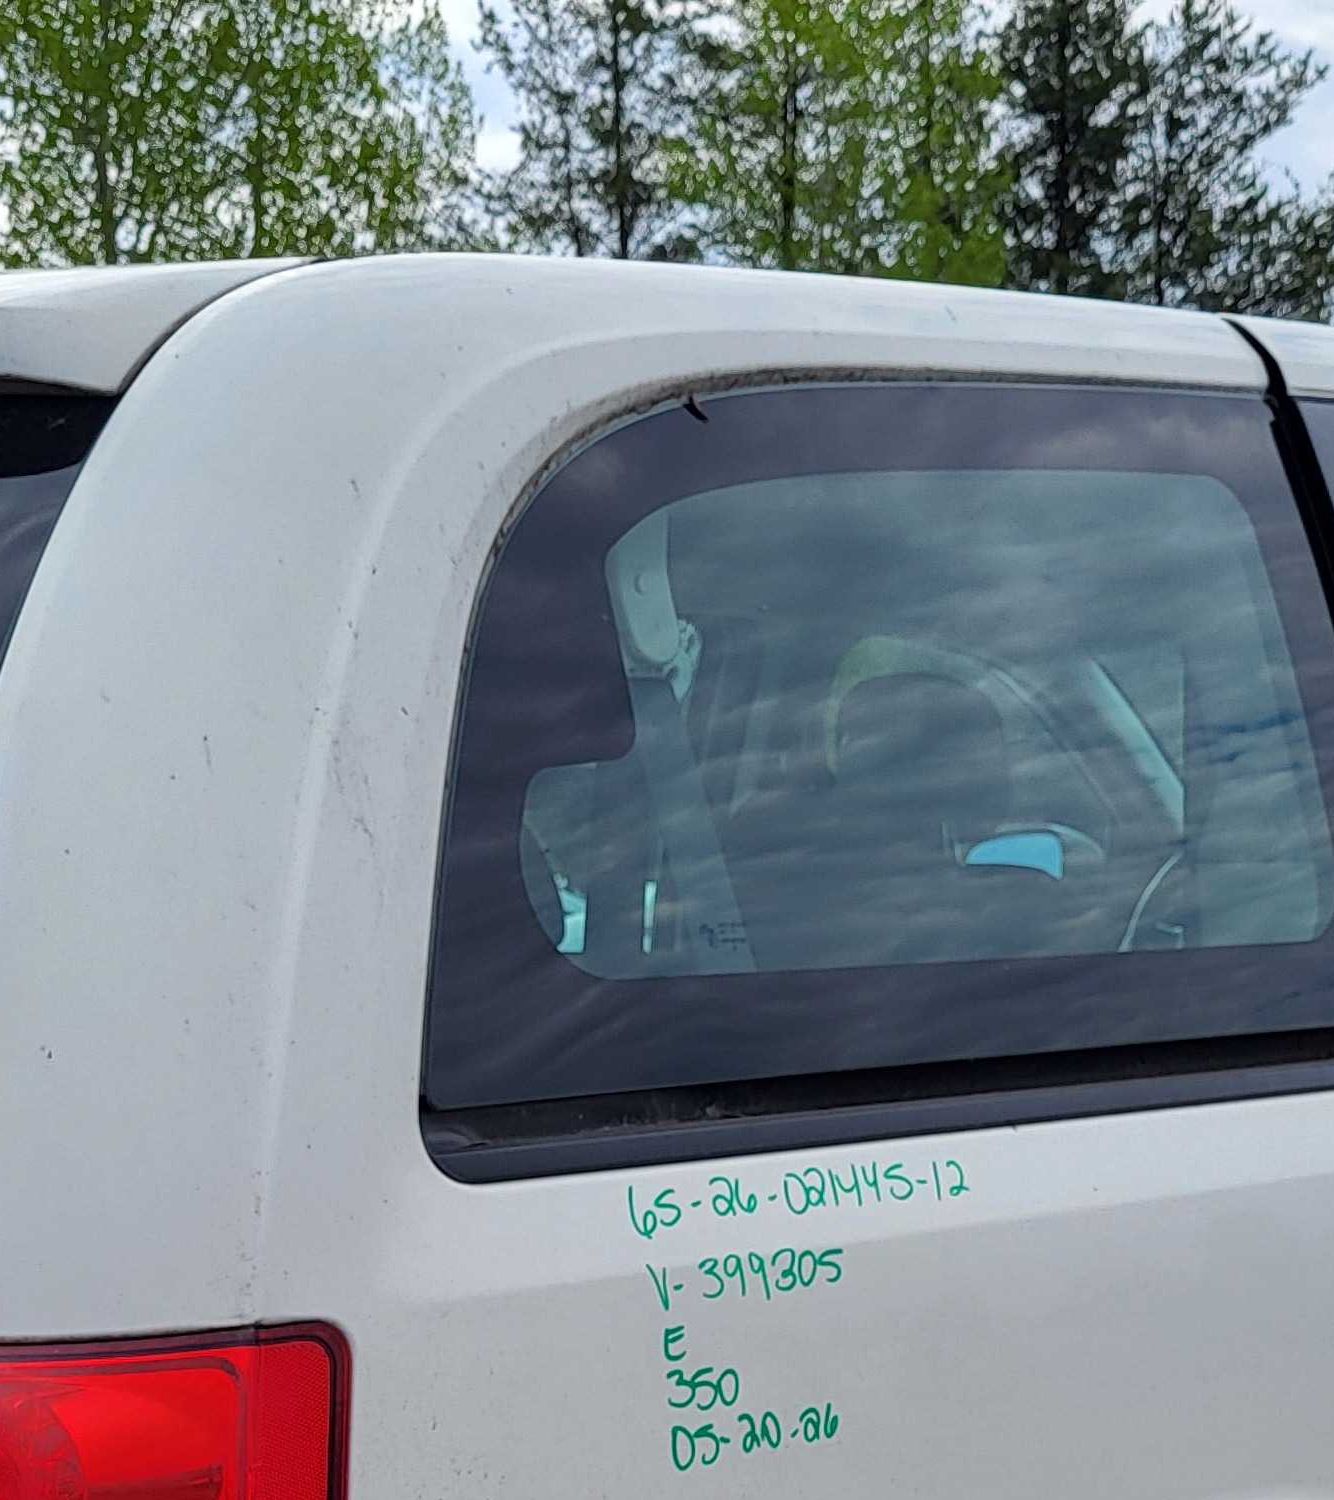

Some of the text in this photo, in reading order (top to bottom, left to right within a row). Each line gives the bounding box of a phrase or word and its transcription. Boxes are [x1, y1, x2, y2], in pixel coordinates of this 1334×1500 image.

[628, 1160, 970, 1239] 65-26-021445-12
[663, 1325, 687, 1361] E
[666, 1367, 740, 1411] 350
[670, 1403, 840, 1471] 05-20-26
